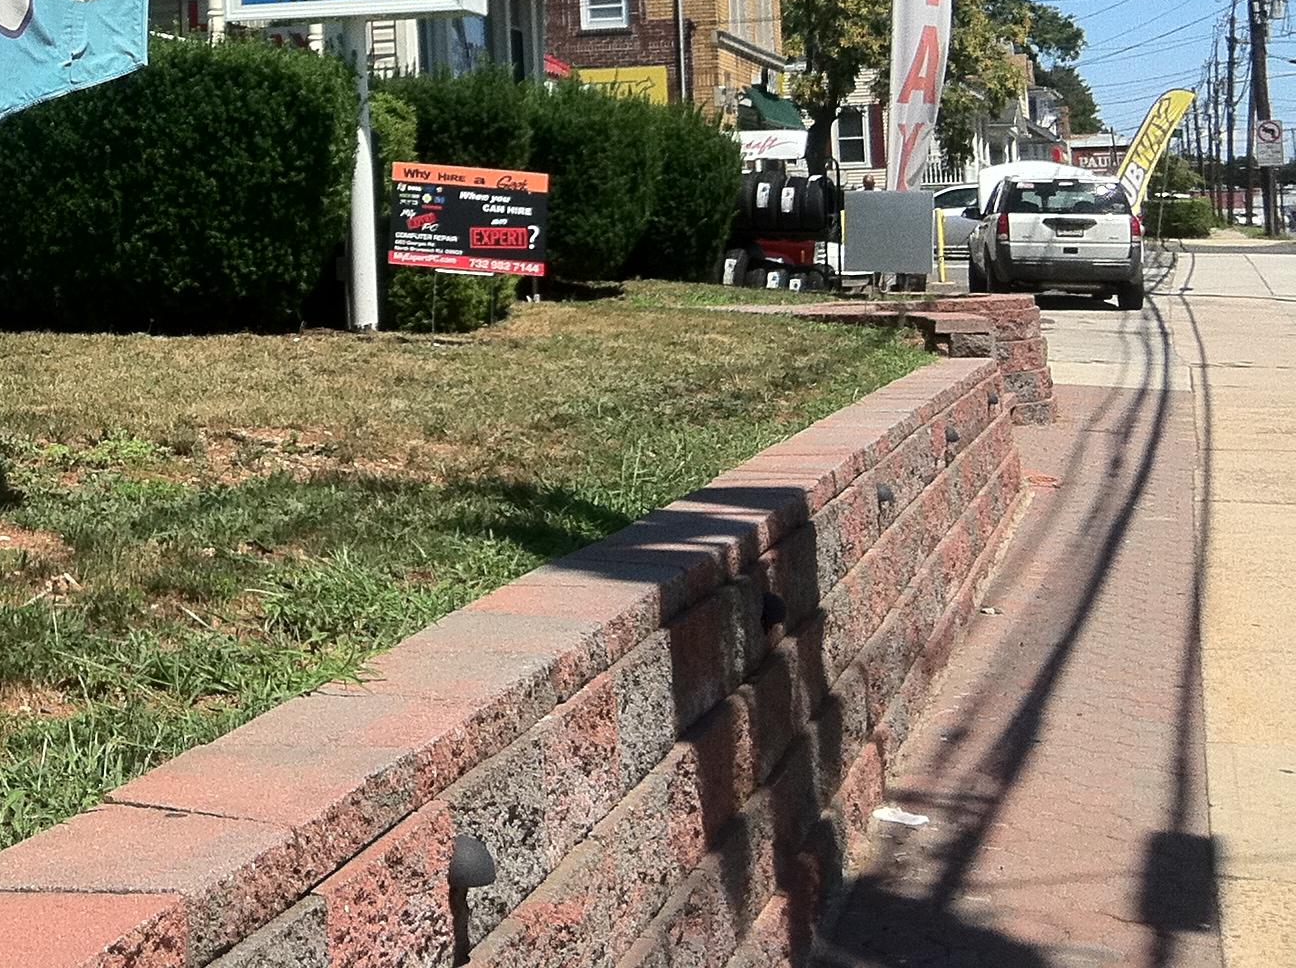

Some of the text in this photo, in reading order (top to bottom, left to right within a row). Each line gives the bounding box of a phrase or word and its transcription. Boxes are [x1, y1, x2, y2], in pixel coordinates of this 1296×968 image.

[403, 168, 431, 181] Why
[437, 172, 466, 182] HIRE
[473, 176, 486, 185] a
[459, 191, 511, 204] When you
[482, 204, 533, 216] CAN HIRE
[472, 229, 524, 246] EXPERT
[512, 262, 540, 273] 7144
